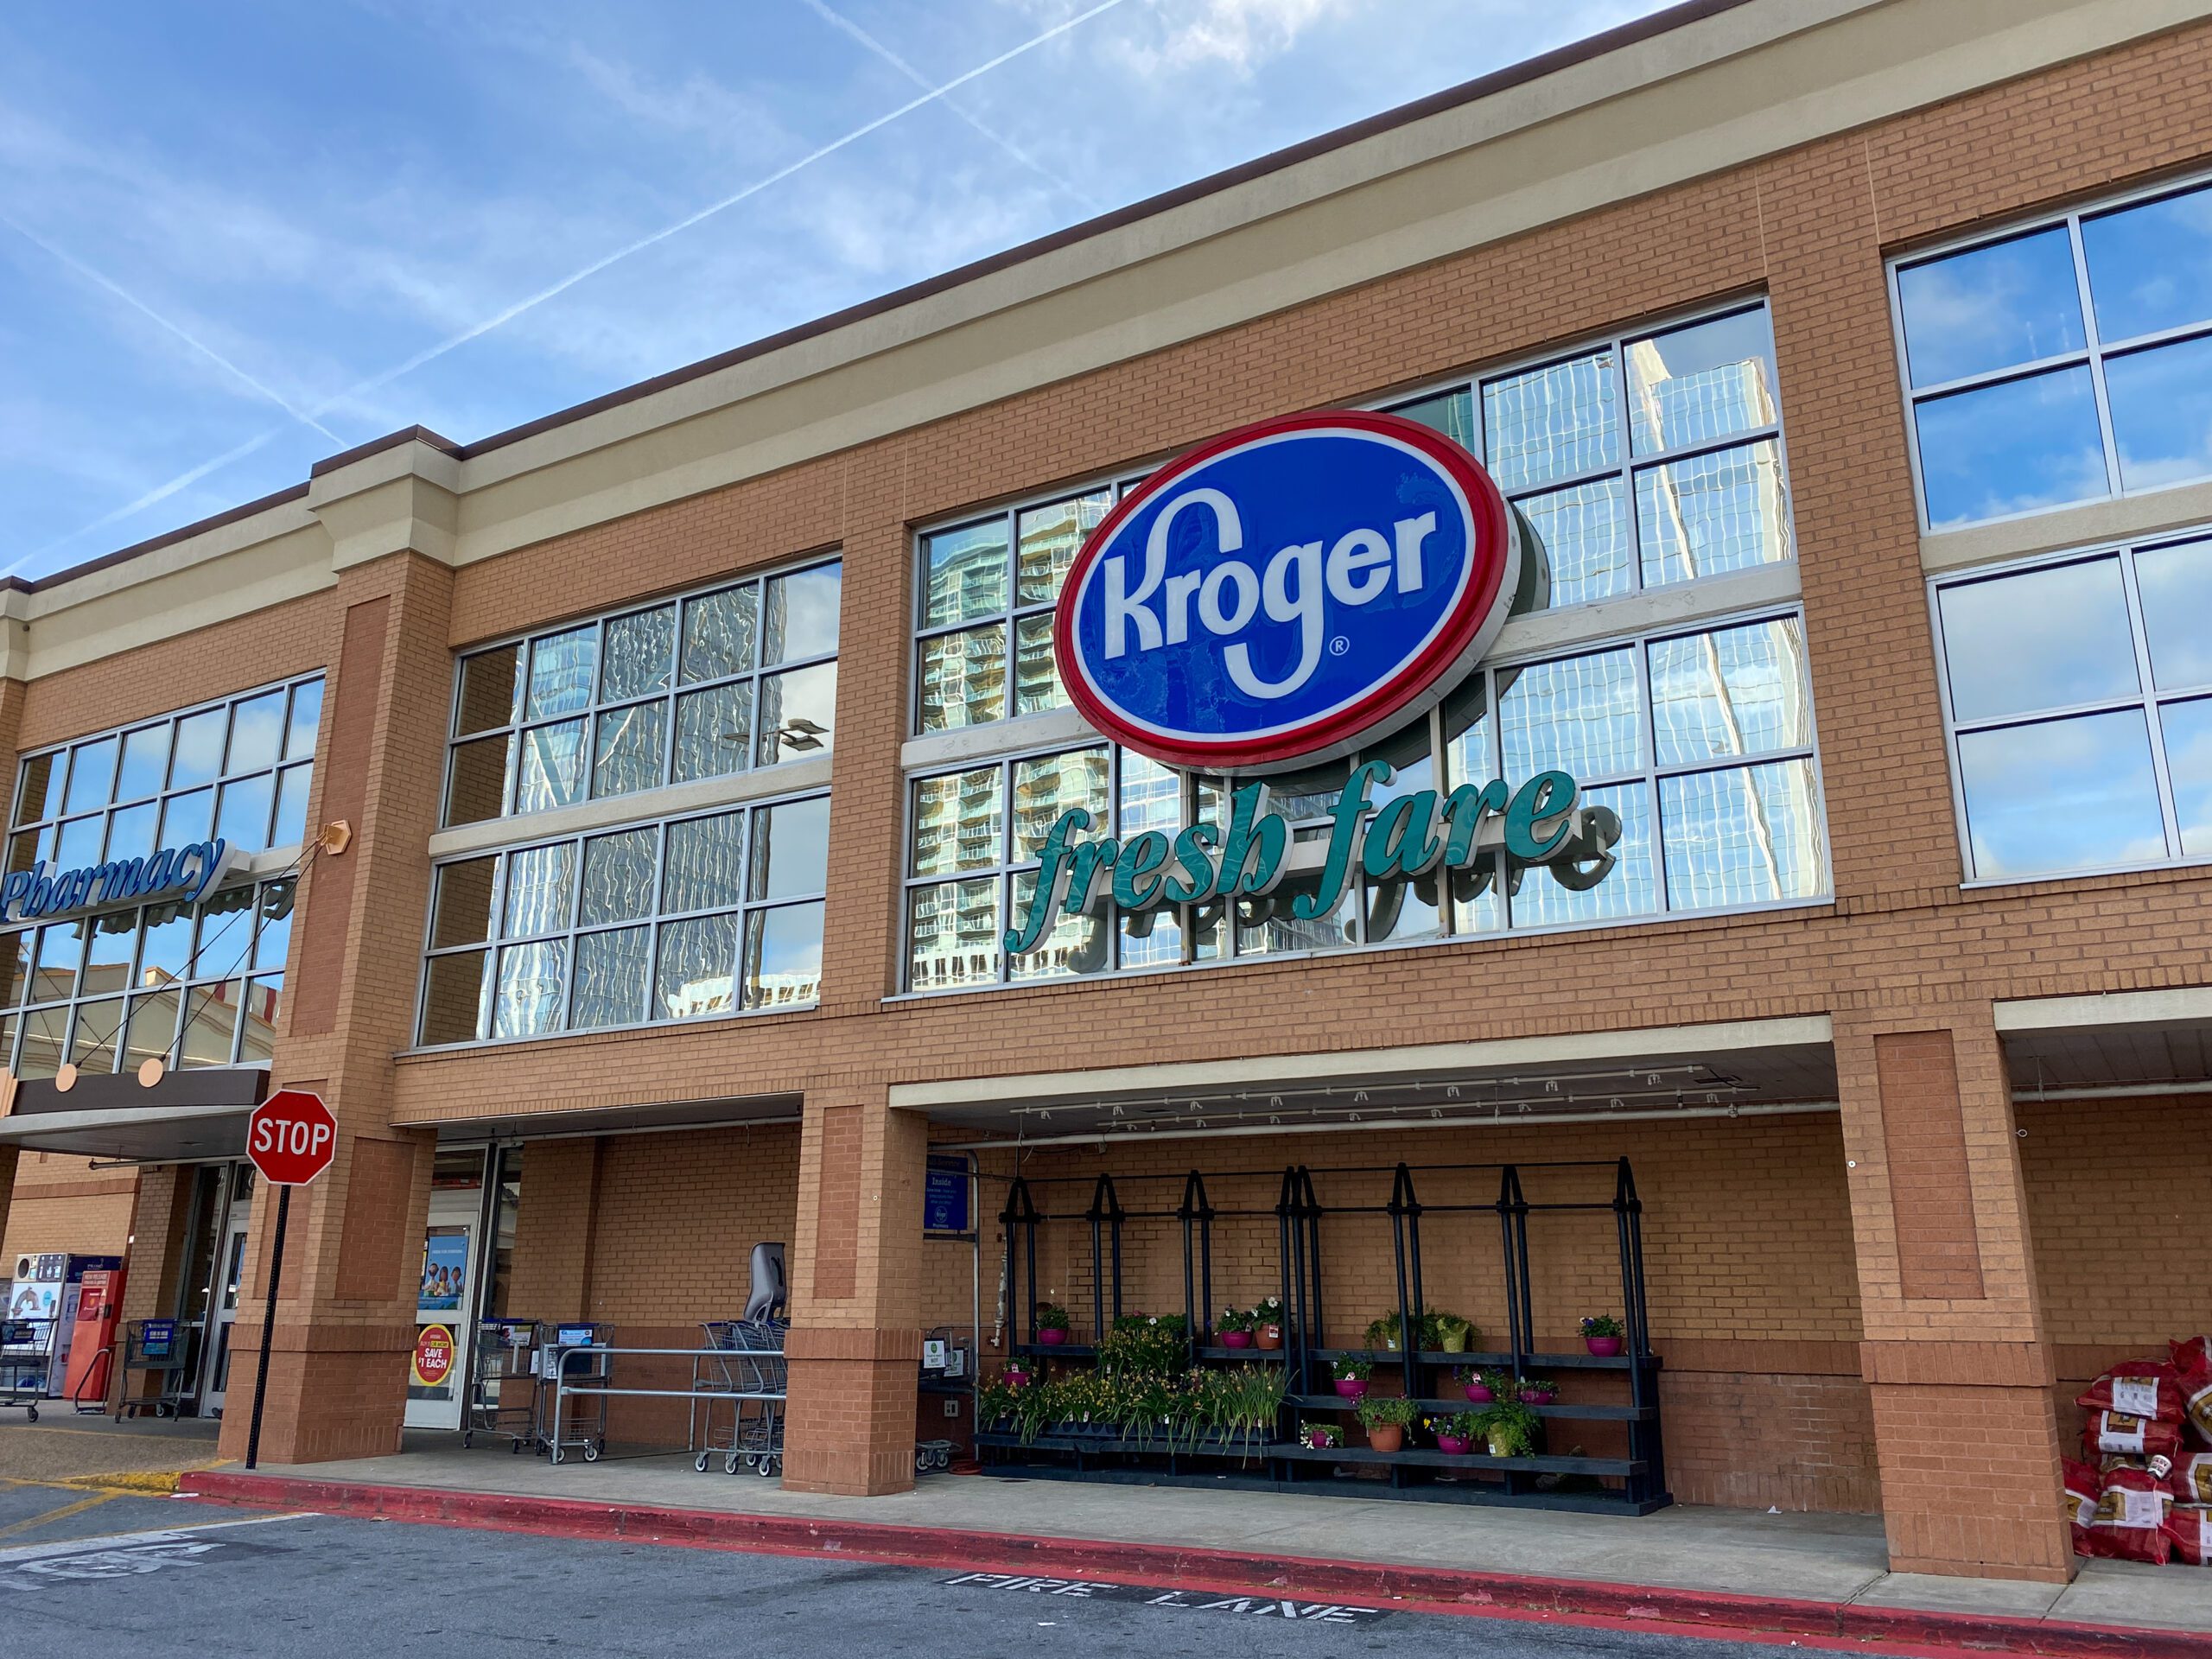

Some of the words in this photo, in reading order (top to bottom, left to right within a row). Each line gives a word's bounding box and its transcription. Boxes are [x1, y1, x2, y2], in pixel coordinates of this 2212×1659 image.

[1103, 487, 1437, 699] Kroger
[0, 838, 227, 923] Pharmacy
[1003, 781, 1294, 956] fresh
[1293, 760, 1581, 922] fare
[254, 1117, 330, 1156] STOP
[932, 1177, 951, 1186] Inside
[418, 1357, 425, 1368] $1
[426, 1358, 447, 1369] EACH
[425, 1348, 442, 1358] SAVE
[944, 1573, 1119, 1598] FIRE
[1145, 1591, 1378, 1624] LANE
